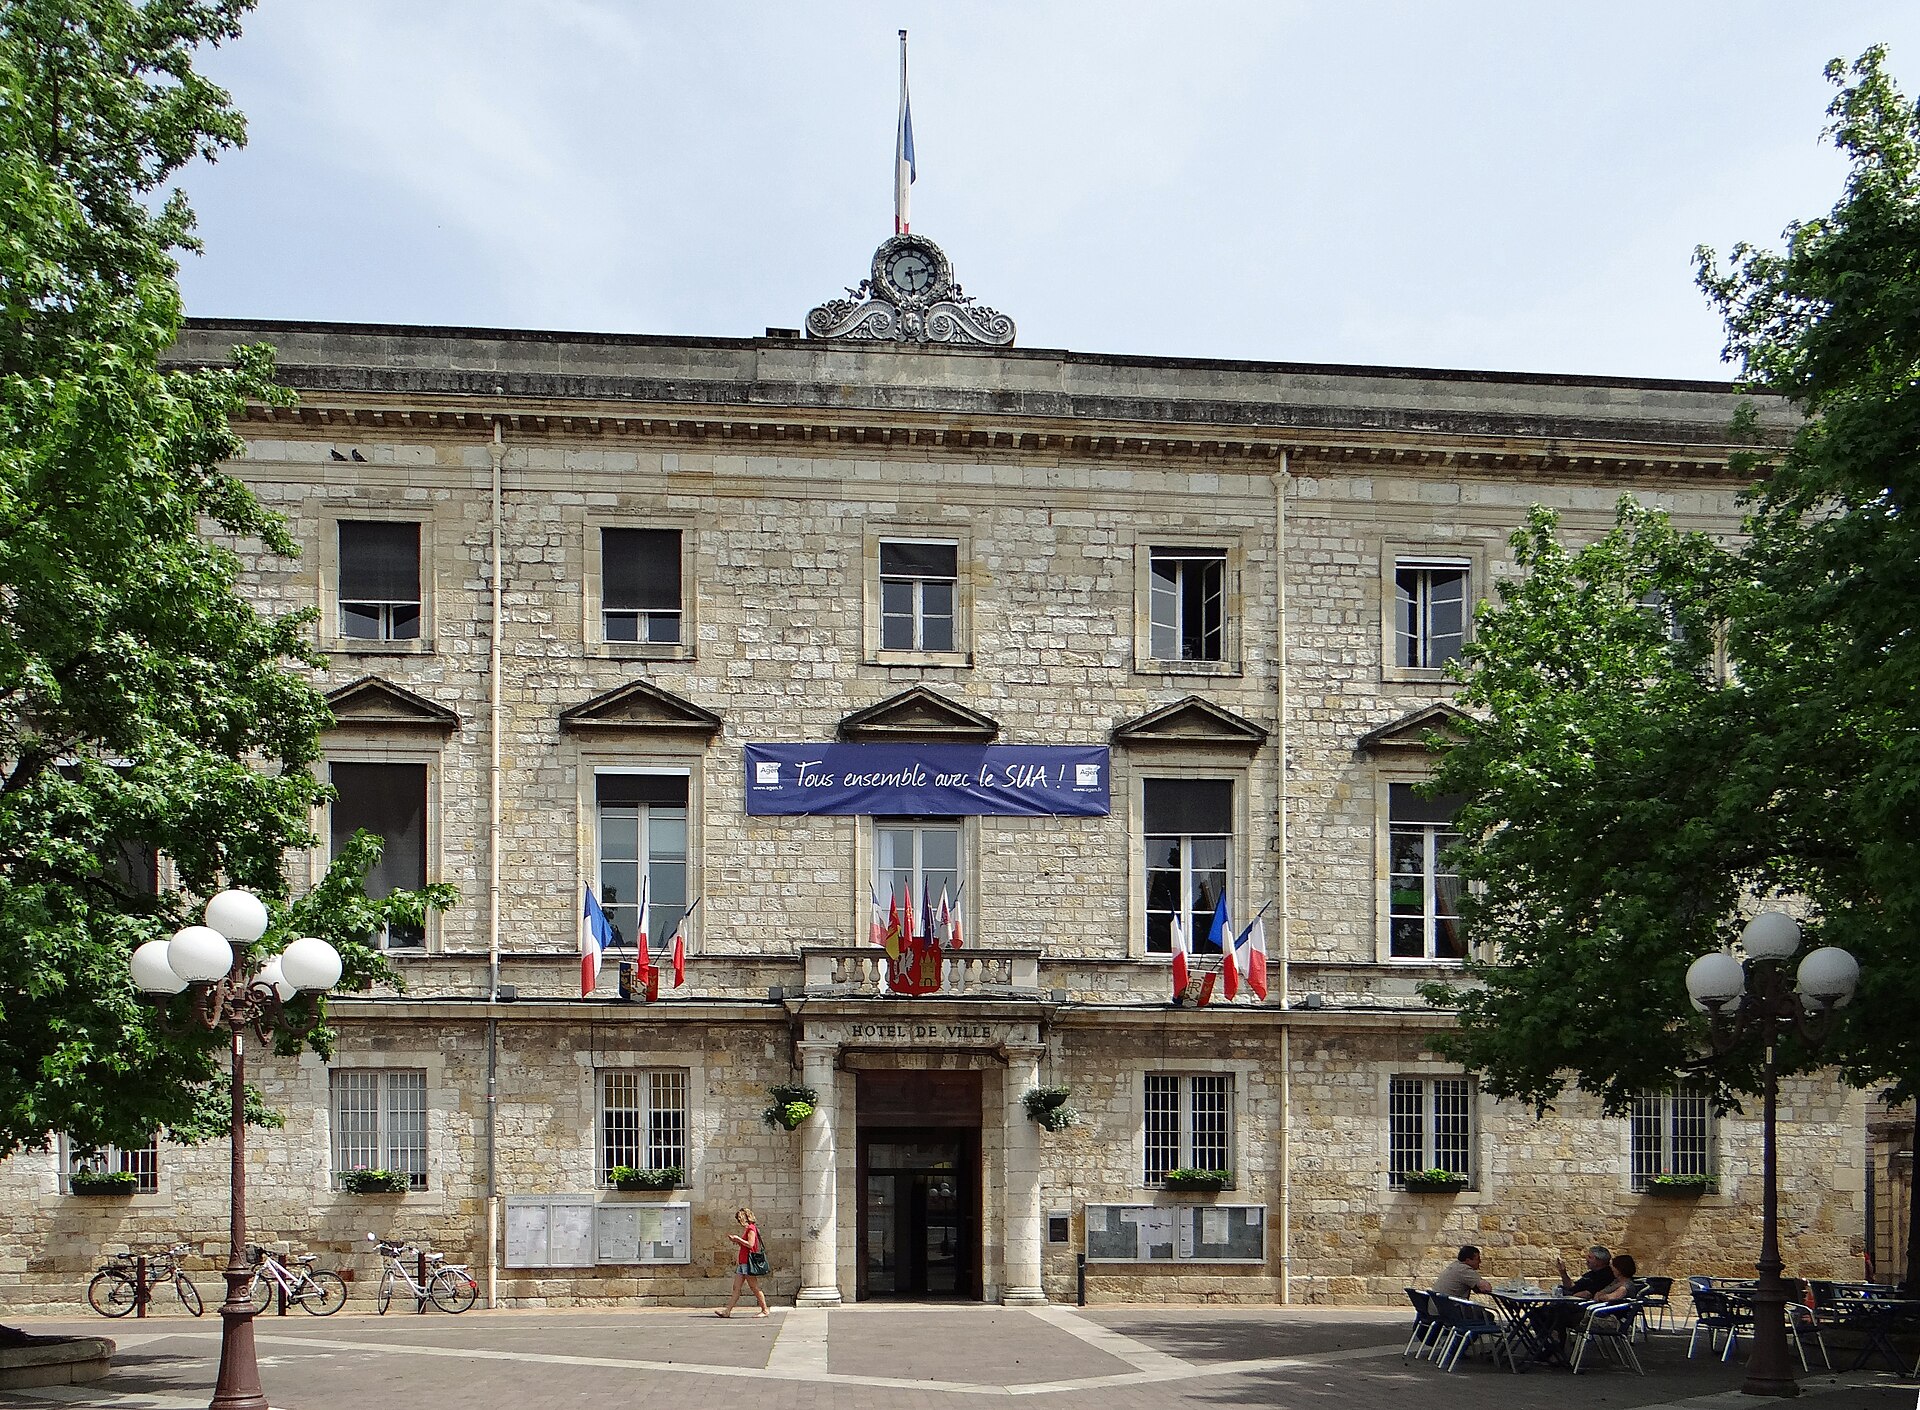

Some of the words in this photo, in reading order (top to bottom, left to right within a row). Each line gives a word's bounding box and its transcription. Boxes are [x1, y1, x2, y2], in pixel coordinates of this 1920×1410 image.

[760, 767, 779, 775] Agen
[794, 761, 834, 788] Tous
[843, 763, 927, 788] ensemble
[935, 772, 971, 788] avec
[979, 764, 995, 788] le
[1001, 764, 1048, 789] SUA
[1080, 769, 1098, 777] Agen
[852, 1025, 906, 1038] HOTEL
[916, 1025, 938, 1038] DE
[946, 1026, 992, 1039] VILLE
